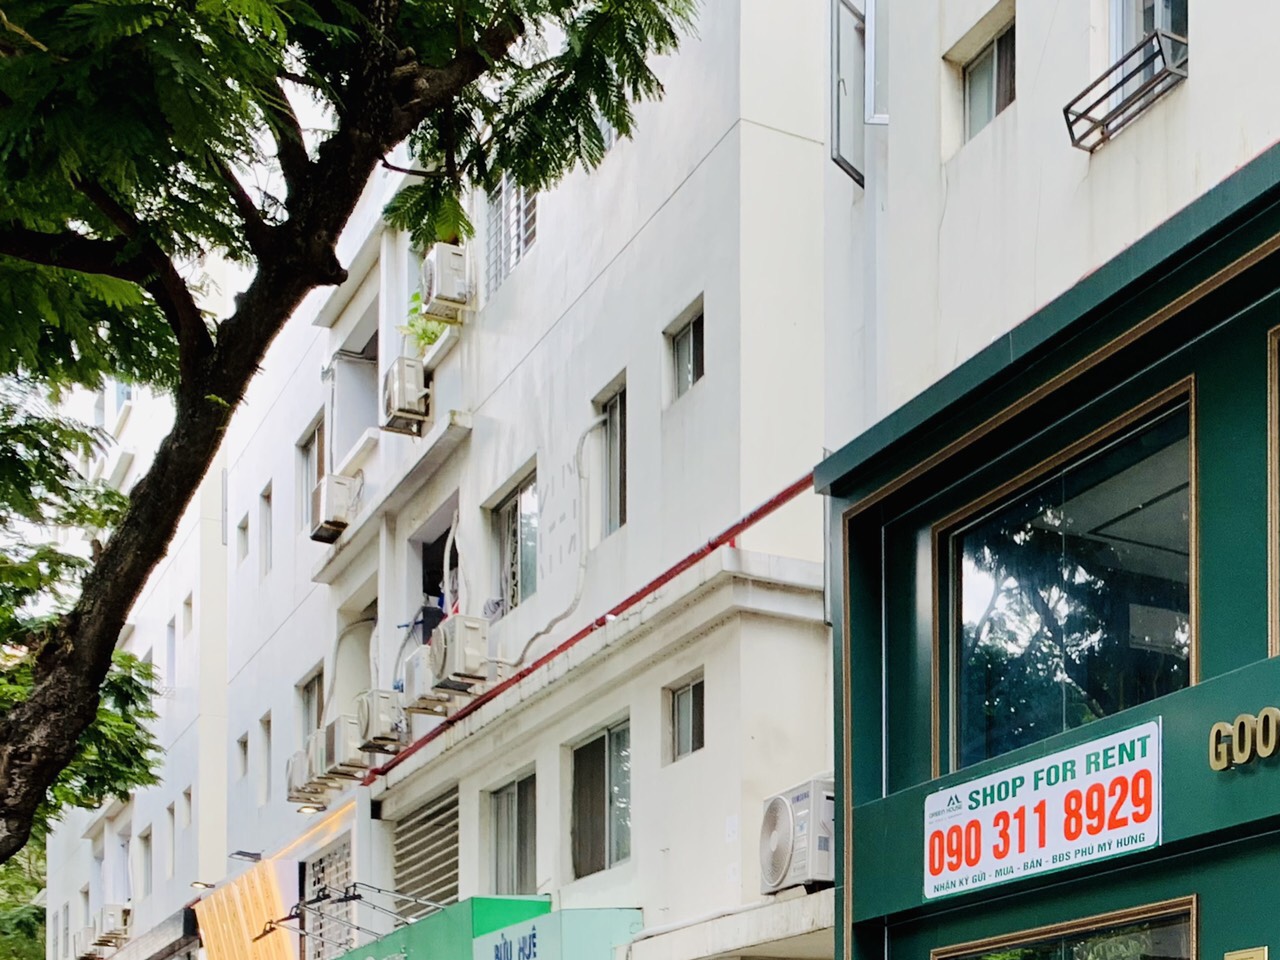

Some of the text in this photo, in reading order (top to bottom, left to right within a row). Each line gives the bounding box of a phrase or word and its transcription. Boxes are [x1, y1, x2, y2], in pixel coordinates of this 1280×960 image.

[968, 734, 1151, 811] SHOP FOR RENT
[928, 768, 1153, 877] 090 311 8929
[994, 865, 1014, 878] MUA
[1052, 851, 1071, 864] BĐS
[1116, 832, 1145, 848] HƯNG
